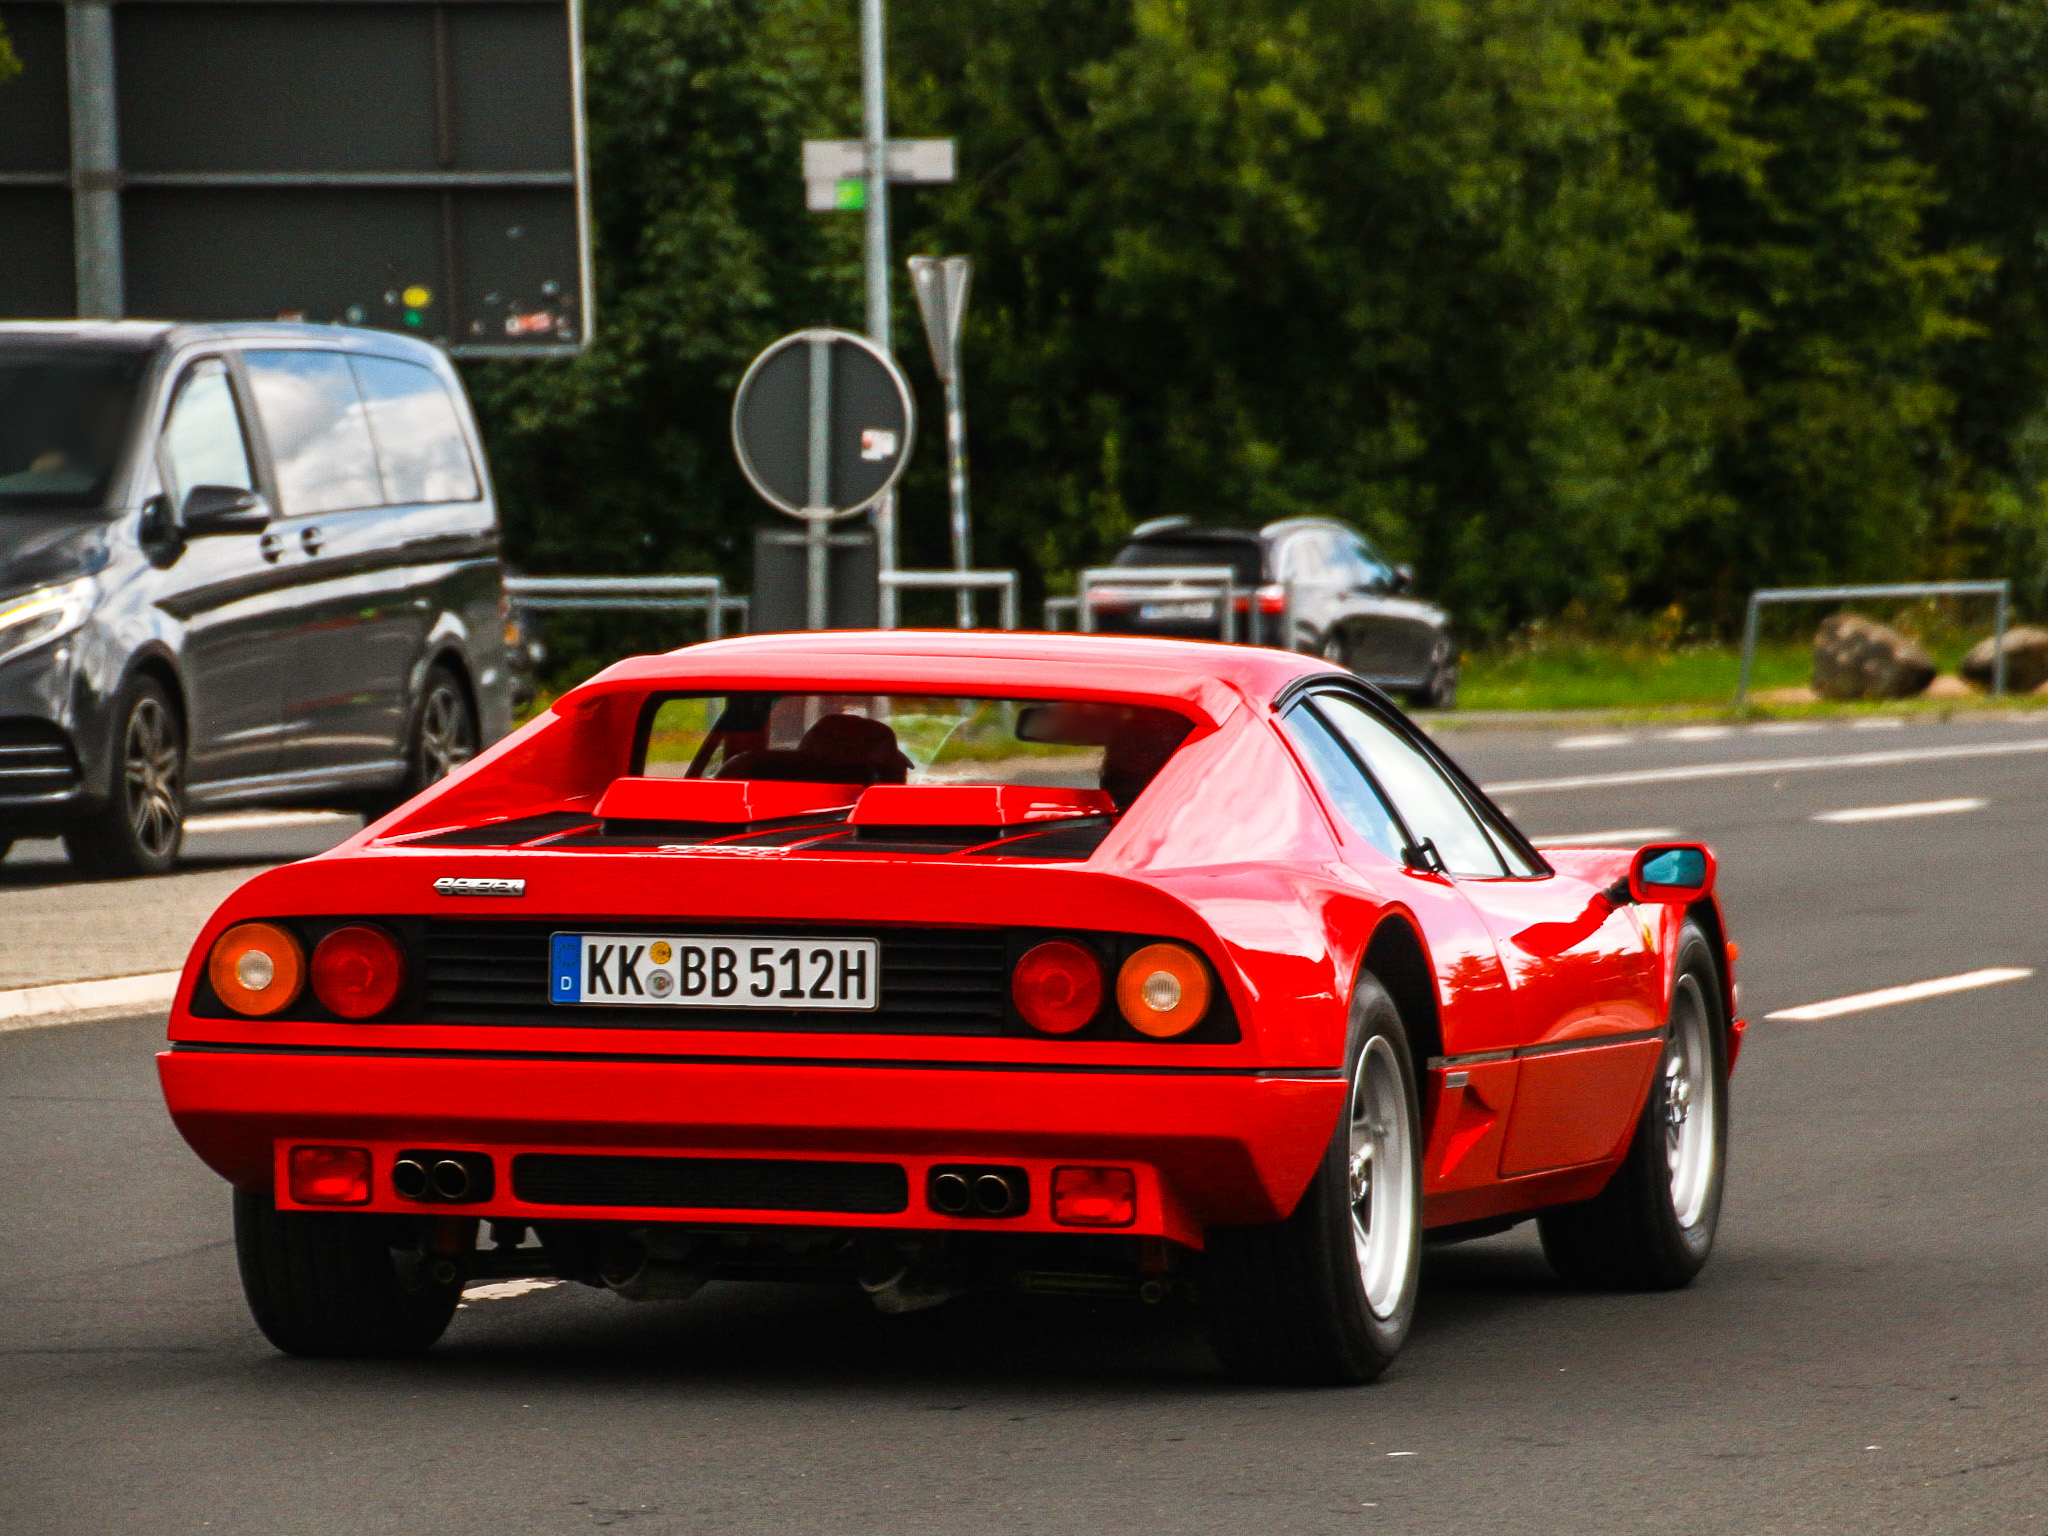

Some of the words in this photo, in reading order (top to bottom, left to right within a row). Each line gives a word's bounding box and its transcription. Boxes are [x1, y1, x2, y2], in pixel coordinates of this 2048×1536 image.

[560, 975, 573, 991] D
[587, 944, 645, 996] KK
[680, 945, 739, 998] BB
[749, 947, 867, 1001] 512H
